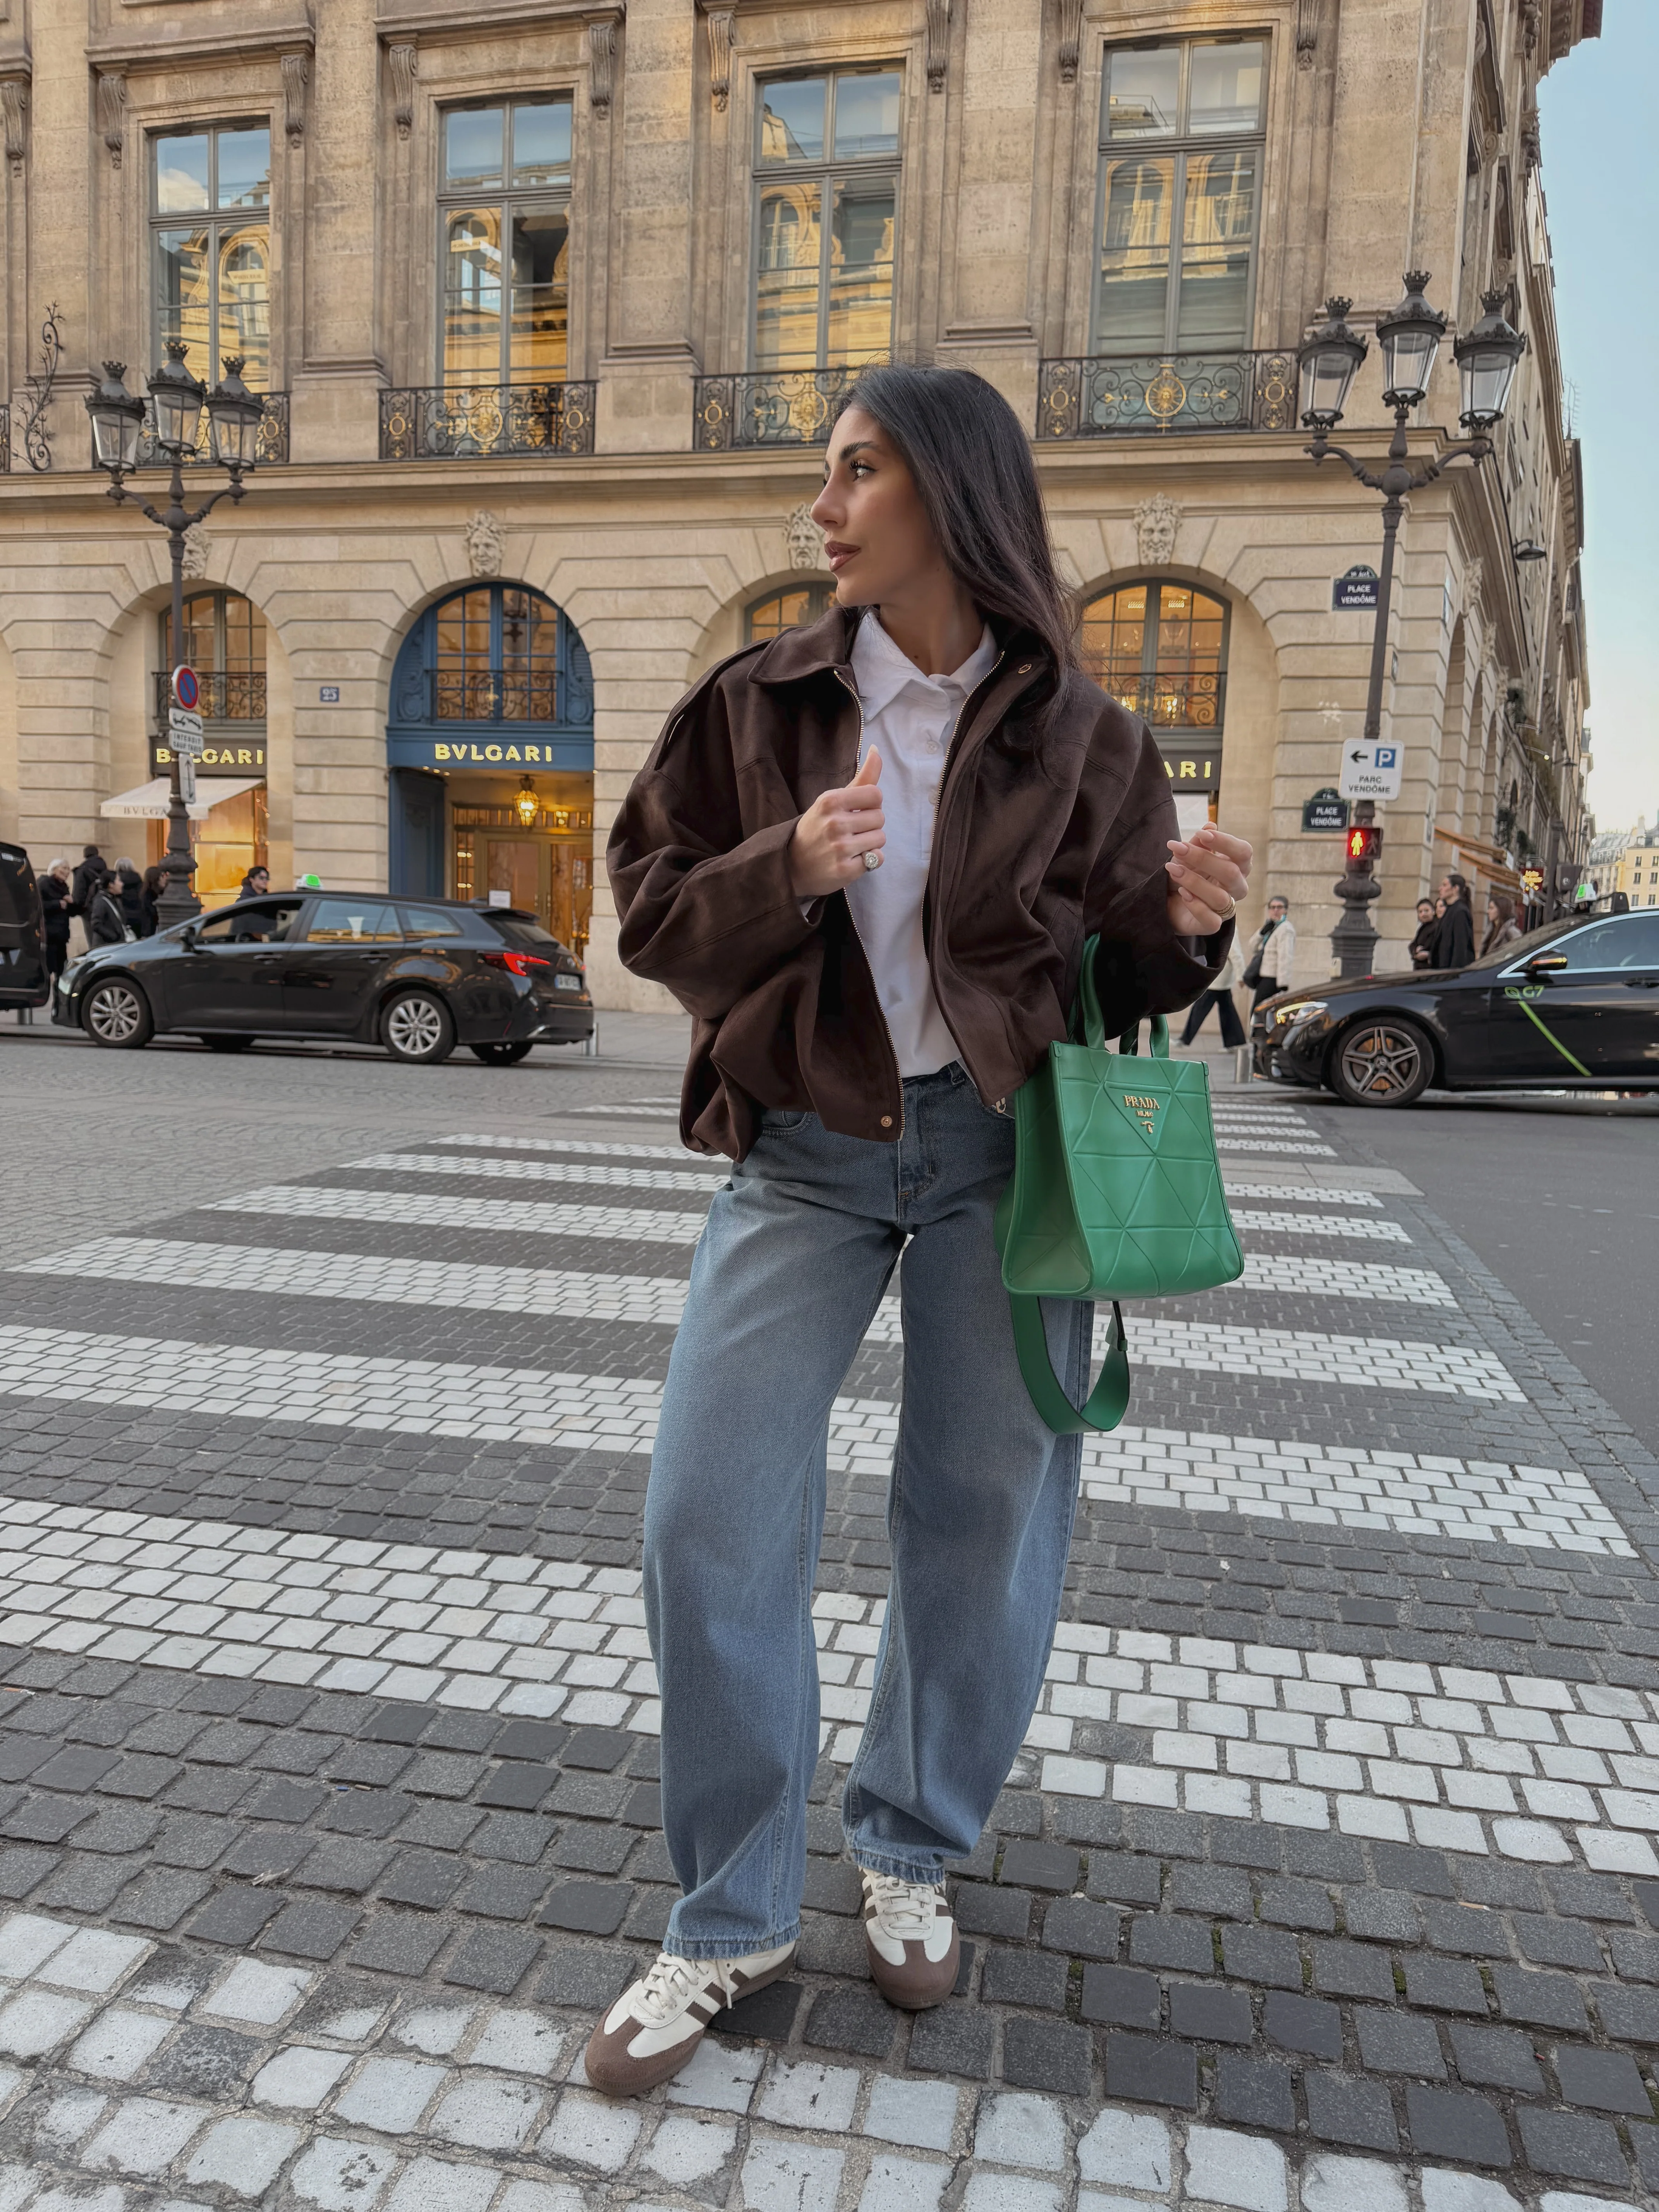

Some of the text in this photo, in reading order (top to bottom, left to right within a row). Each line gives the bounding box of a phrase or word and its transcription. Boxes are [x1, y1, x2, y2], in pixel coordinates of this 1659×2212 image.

[1347, 584, 1371, 593] PLACE
[1341, 593, 1377, 604] VENDÔME
[173, 733, 201, 745] INTERDIT
[435, 744, 552, 762] BVLGARI
[1379, 750, 1392, 767] P
[1359, 775, 1382, 784] PARC
[1348, 784, 1391, 793] VENDÔME
[1316, 807, 1338, 816] PLACE
[1310, 816, 1343, 826] VENDÔME
[1523, 985, 1545, 998] G7
[1124, 1095, 1160, 1109] PRADA
